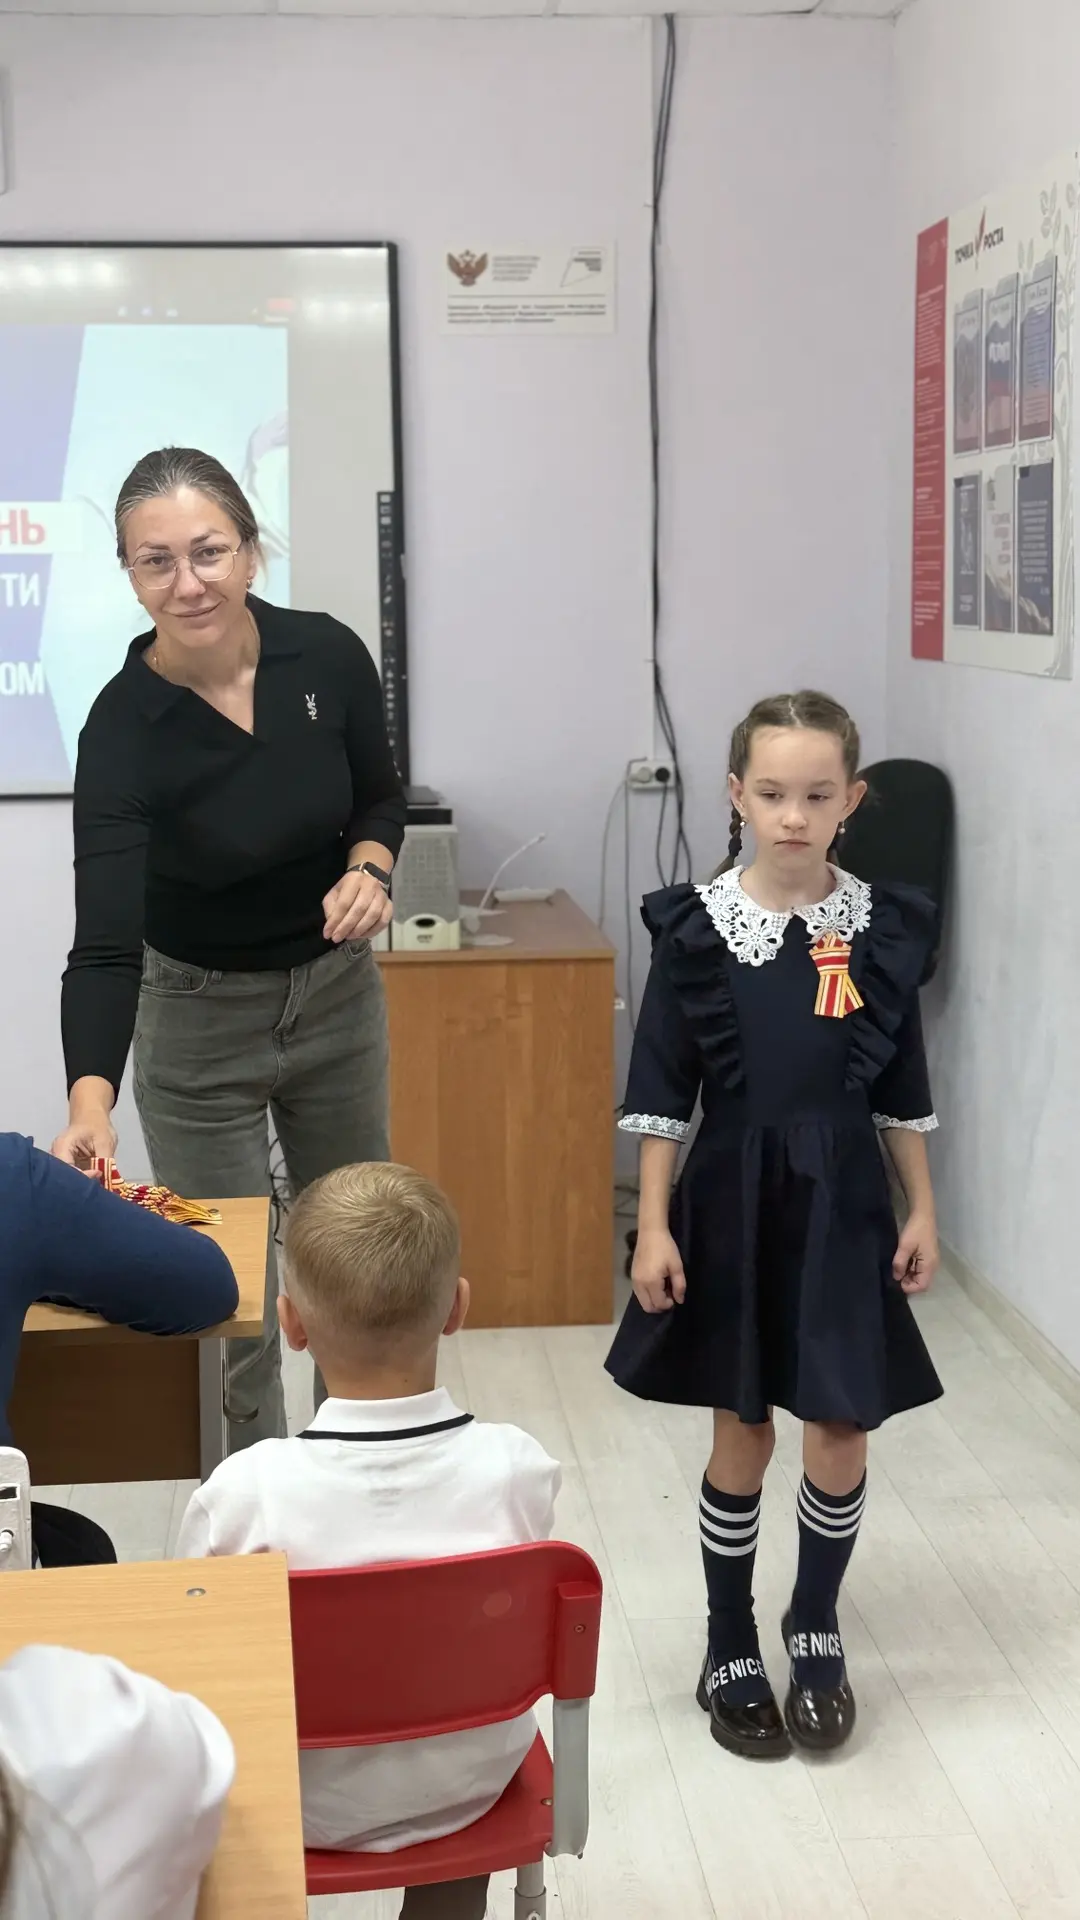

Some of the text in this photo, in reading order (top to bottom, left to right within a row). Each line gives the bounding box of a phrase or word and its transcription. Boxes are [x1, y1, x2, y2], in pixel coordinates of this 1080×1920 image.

[0, 572, 40, 607] ТИ
[0, 661, 45, 696] ОМ
[810, 1631, 842, 1657] NICE
[729, 1657, 766, 1681] NICE
